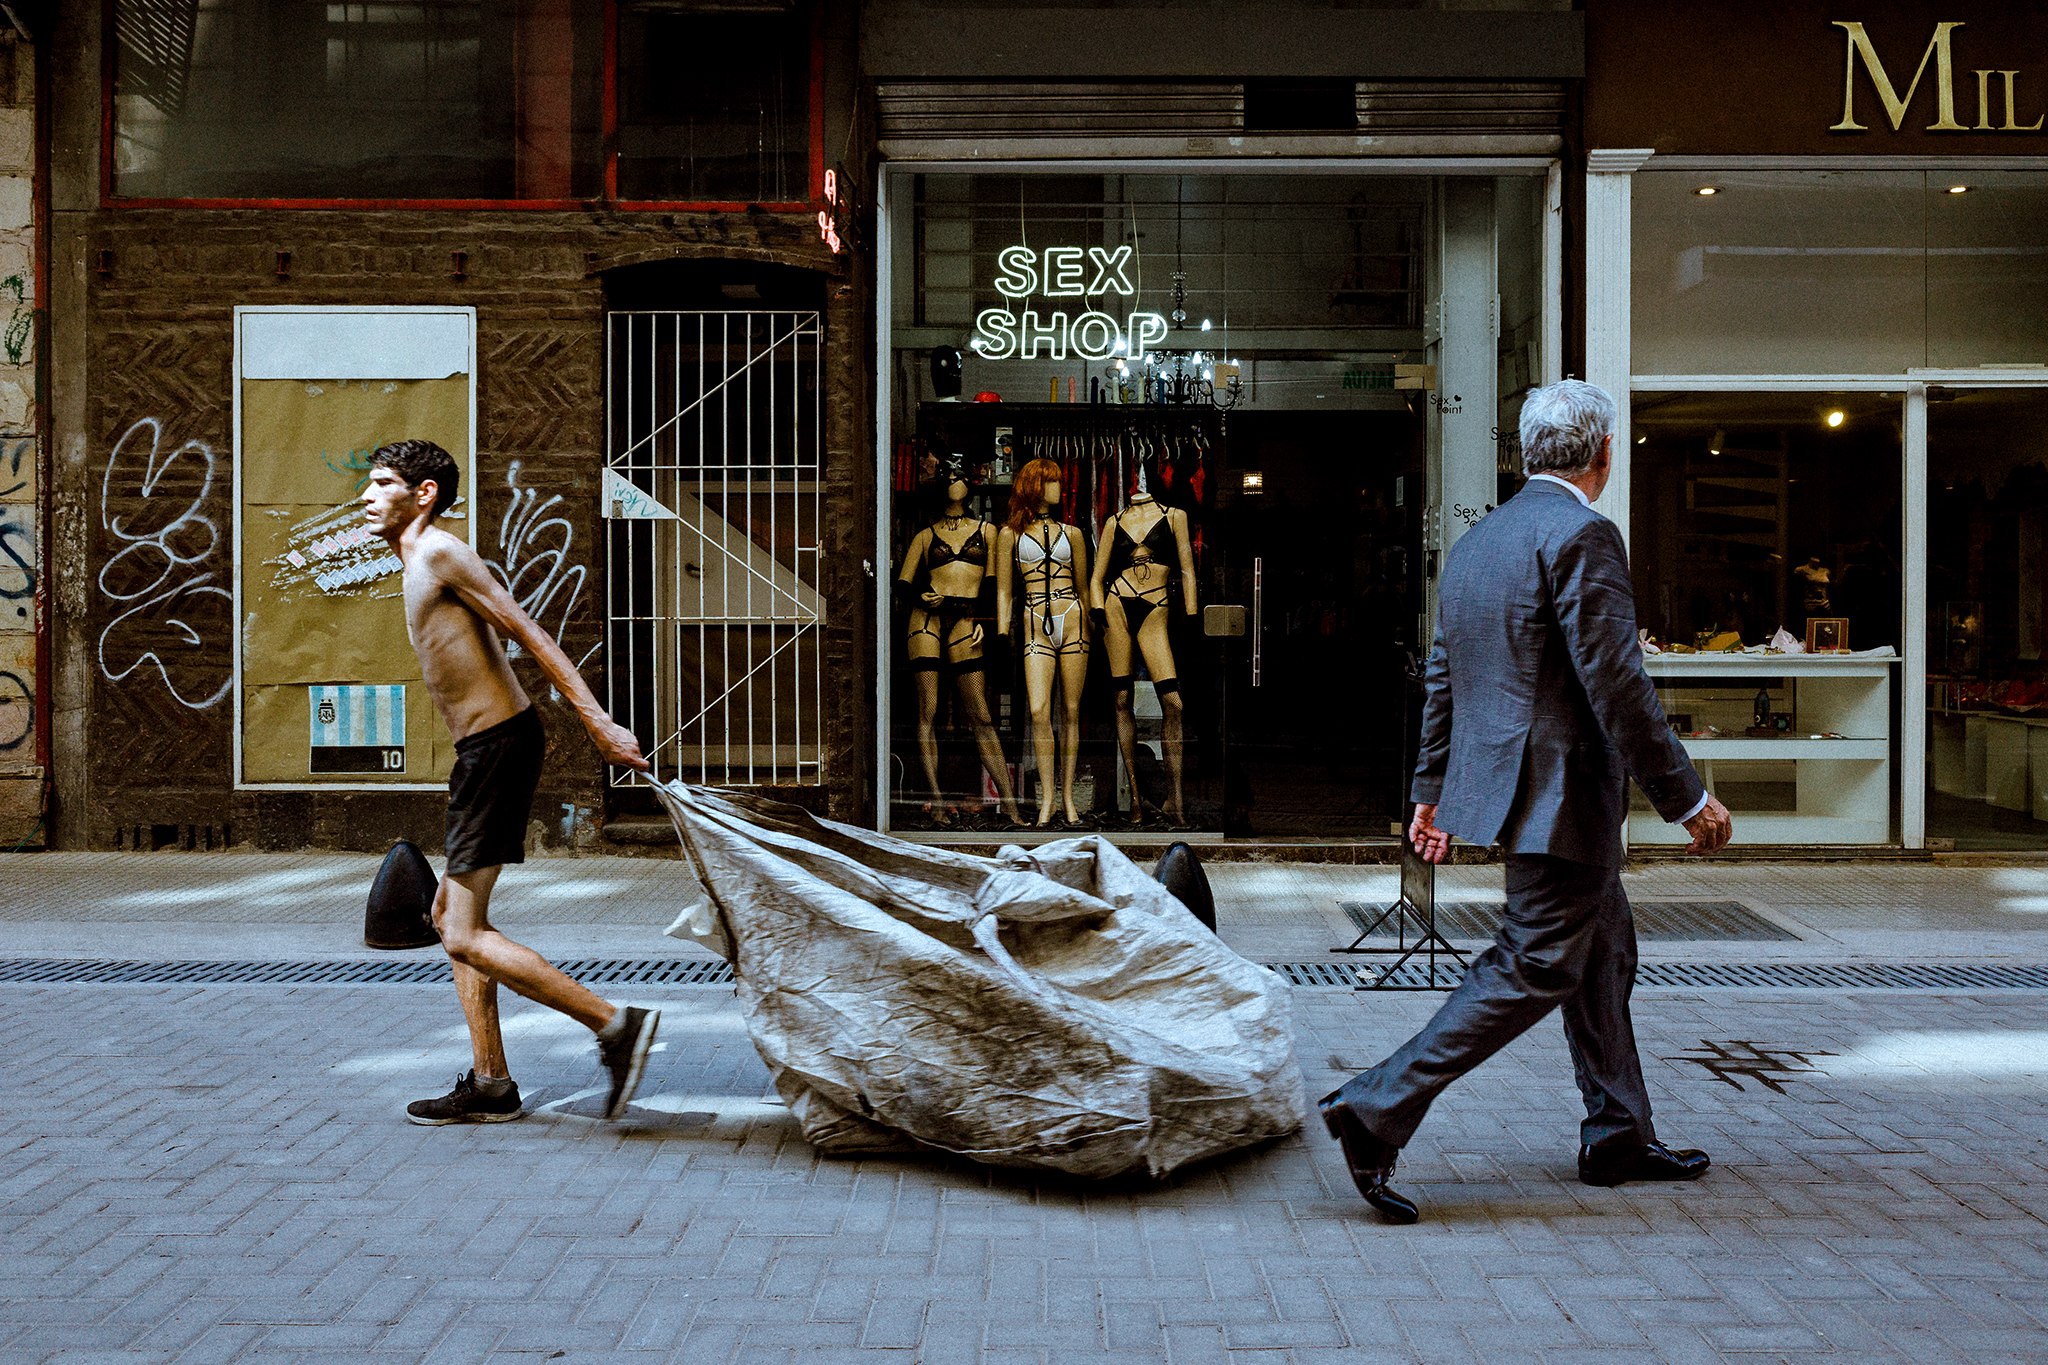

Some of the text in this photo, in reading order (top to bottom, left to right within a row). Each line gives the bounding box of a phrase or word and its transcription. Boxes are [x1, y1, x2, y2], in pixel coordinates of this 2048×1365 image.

[1829, 21, 2045, 131] MIL
[994, 245, 1134, 298] SEX
[976, 308, 1168, 361] SHOP
[1430, 394, 1449, 405] Sex
[1436, 403, 1462, 414] Point
[1453, 503, 1479, 517] Sex
[382, 750, 402, 769] 10
